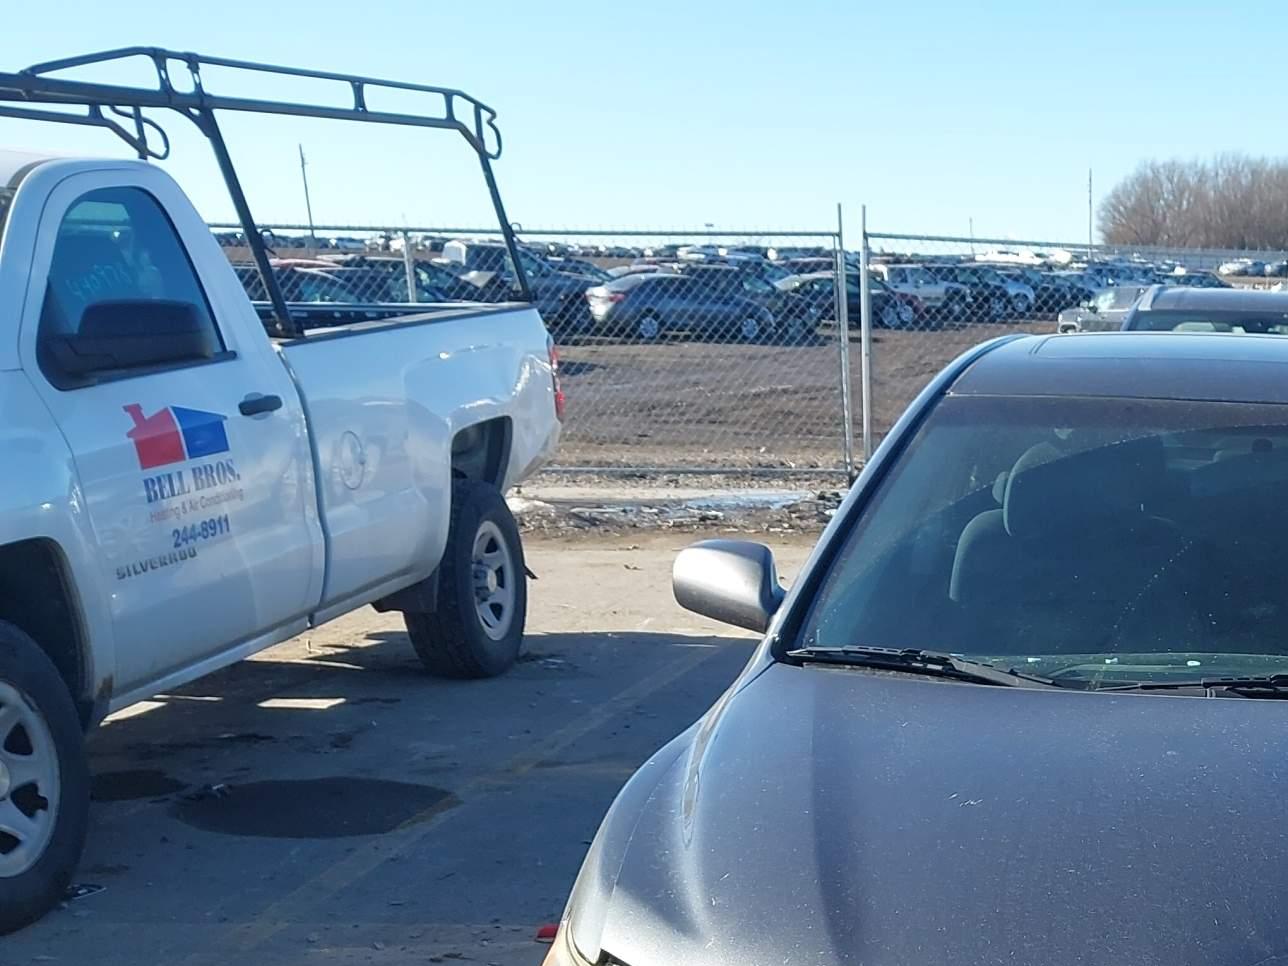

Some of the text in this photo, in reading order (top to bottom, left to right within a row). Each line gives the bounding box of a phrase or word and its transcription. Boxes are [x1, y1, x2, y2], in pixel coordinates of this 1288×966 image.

[143, 459, 240, 503] BELL BROS.
[172, 513, 230, 548] 244-8911
